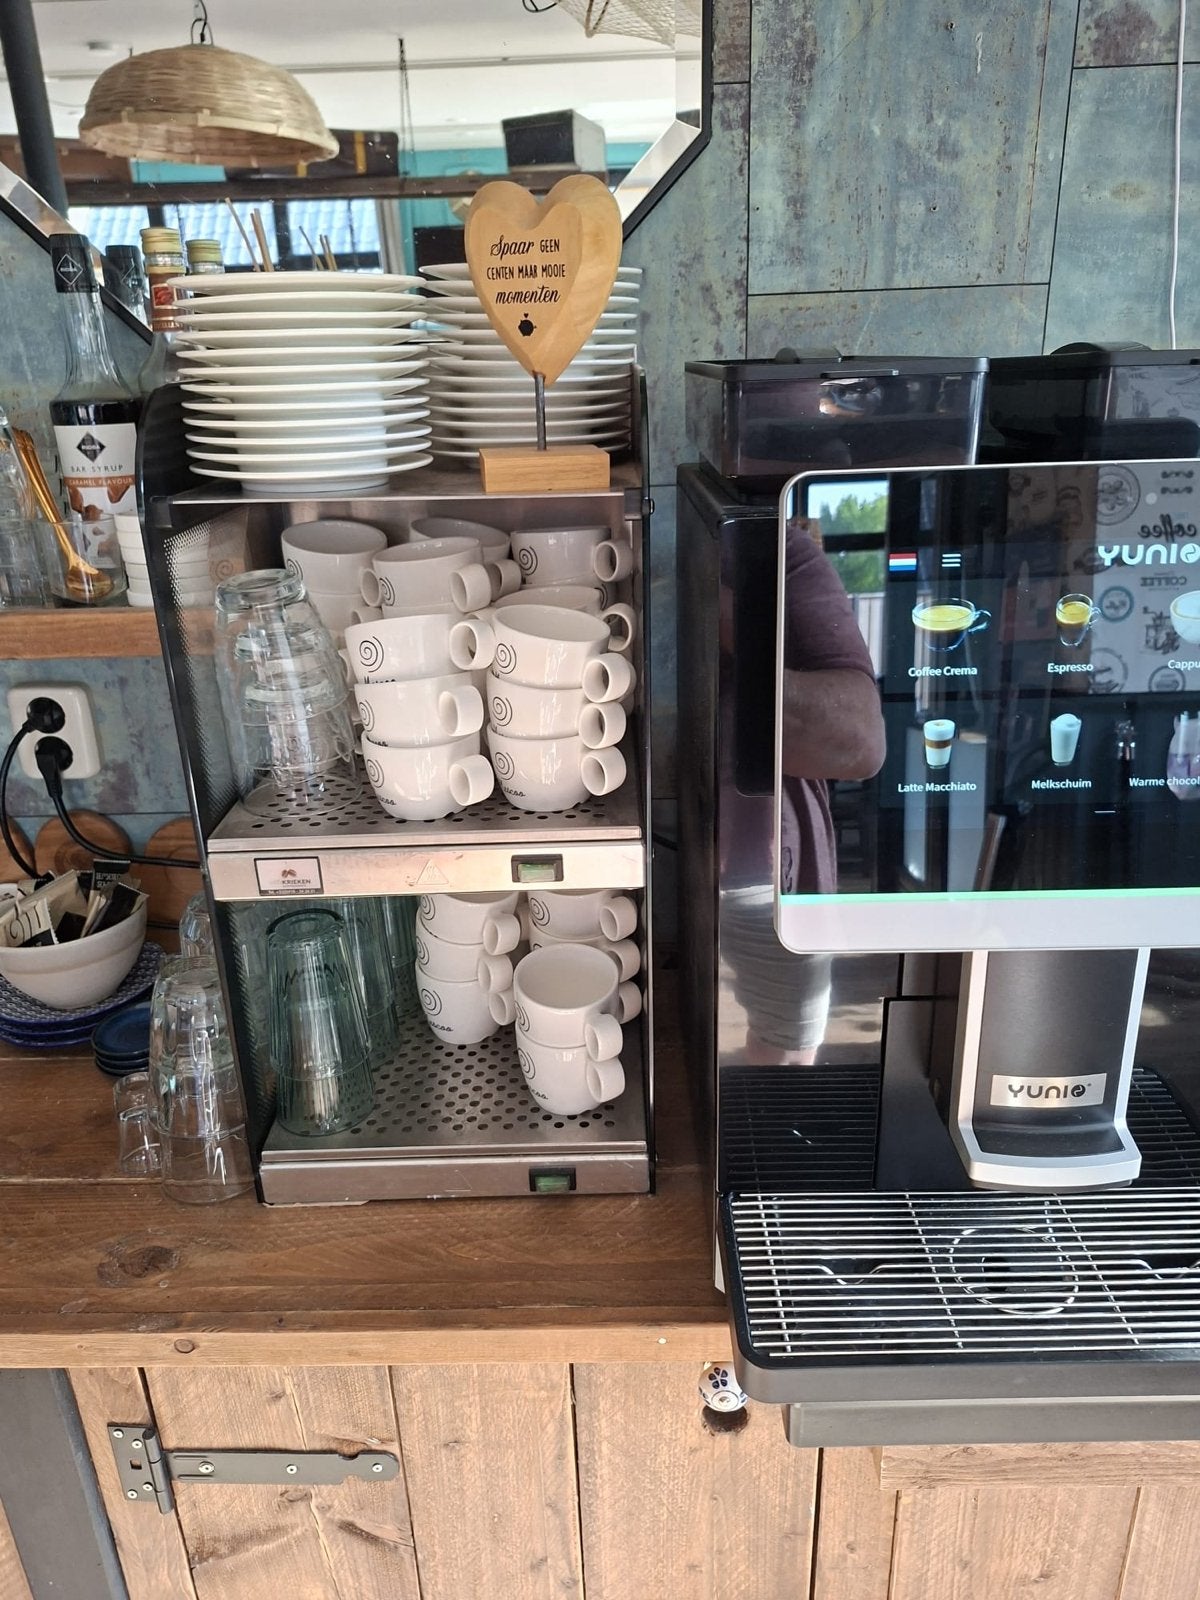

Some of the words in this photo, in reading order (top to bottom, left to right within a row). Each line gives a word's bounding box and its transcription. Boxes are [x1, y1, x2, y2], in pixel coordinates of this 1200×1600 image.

[490, 234, 534, 261] Spaar
[540, 239, 560, 253] GEEN
[486, 266, 514, 281] CENTEN
[518, 265, 538, 279] MAAR
[541, 264, 566, 278] MOOIE
[495, 285, 561, 305] momenten
[71, 465, 87, 473] BAR
[91, 464, 124, 473] SYRUP
[69, 478, 97, 486] CARAMEL
[98, 477, 134, 486] FLAVOUR
[908, 665, 941, 677] Coffee
[943, 664, 978, 676] Crema
[1047, 662, 1094, 674] Espresso
[897, 781, 922, 793] Latte
[923, 780, 977, 792] Macchiato
[1031, 777, 1092, 790] Melkschuim
[1129, 776, 1165, 787] Warme
